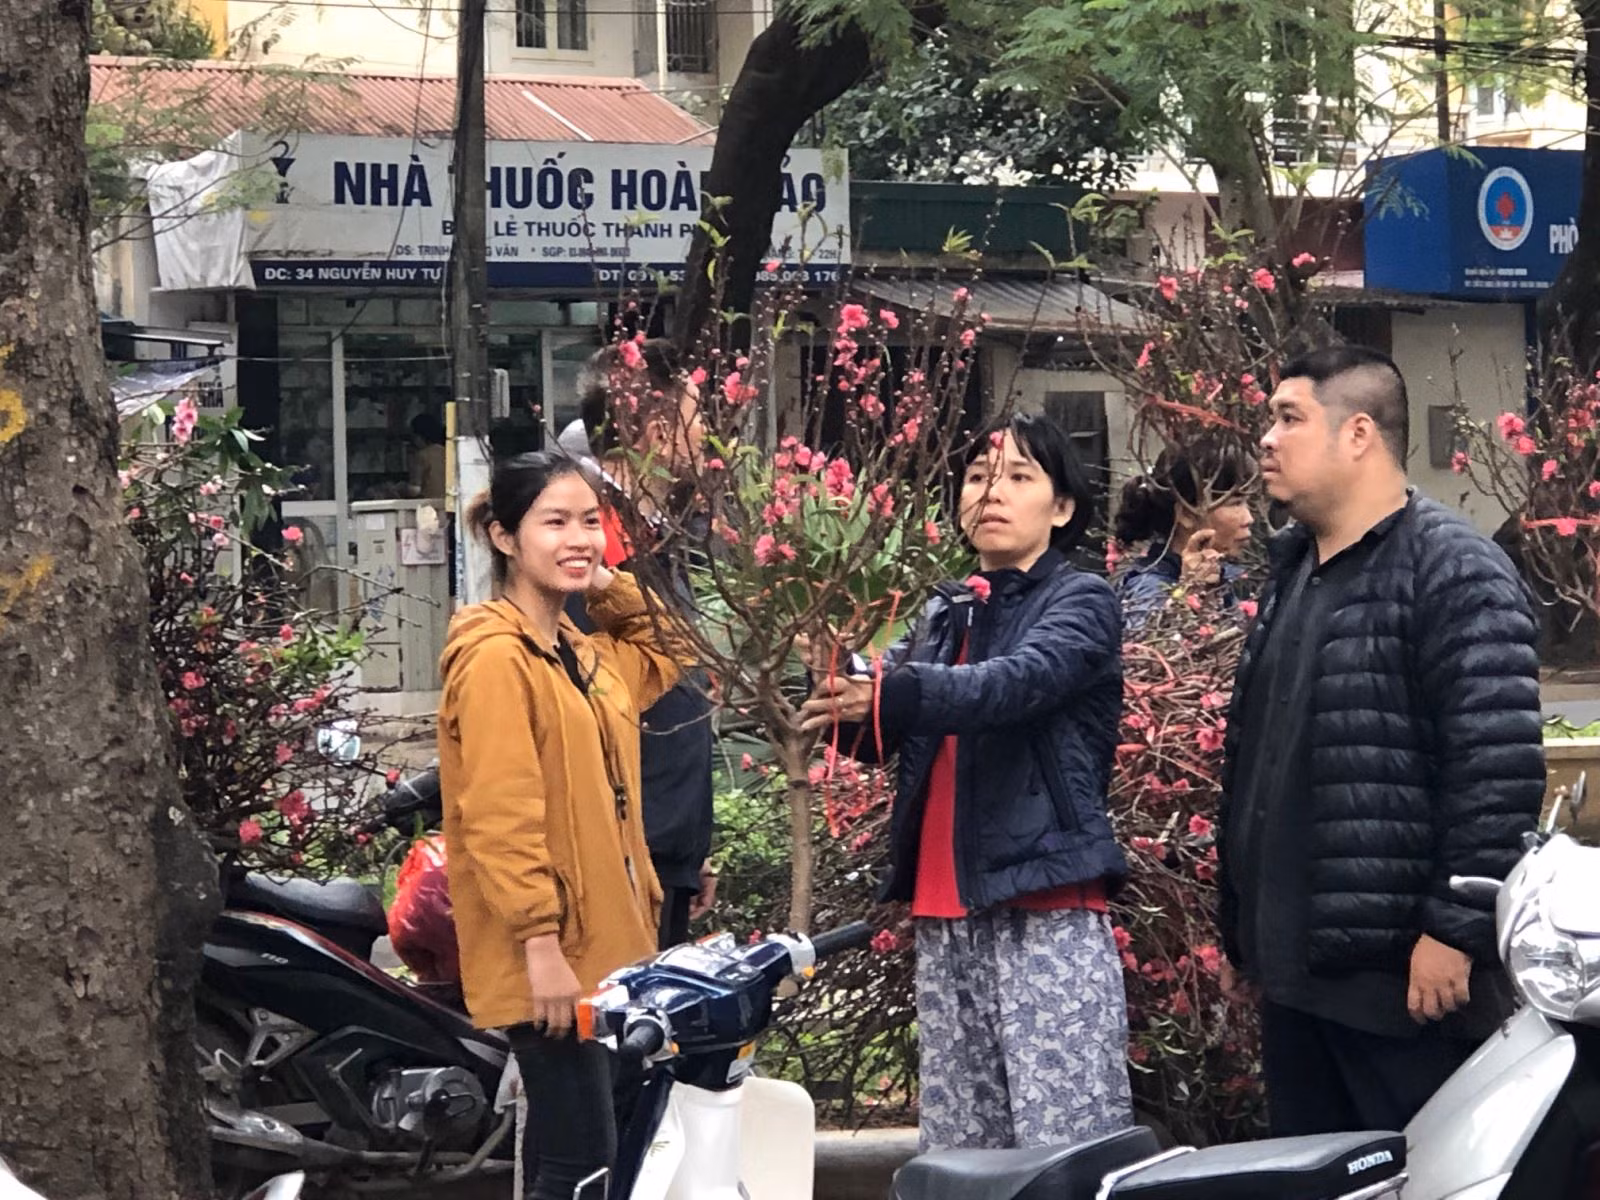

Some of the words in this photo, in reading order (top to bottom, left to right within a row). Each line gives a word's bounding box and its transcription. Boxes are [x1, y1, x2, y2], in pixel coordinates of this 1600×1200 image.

[334, 154, 432, 207] NHÀ
[485, 151, 595, 210] HUỐC
[611, 160, 711, 212] HOÀ
[778, 154, 826, 214] ẢO
[1548, 216, 1579, 255] PHÒ
[295, 267, 314, 280] 34
[318, 262, 382, 280] NGUYỄN
[386, 267, 417, 280] HUY
[1347, 1150, 1393, 1175] HONDA
